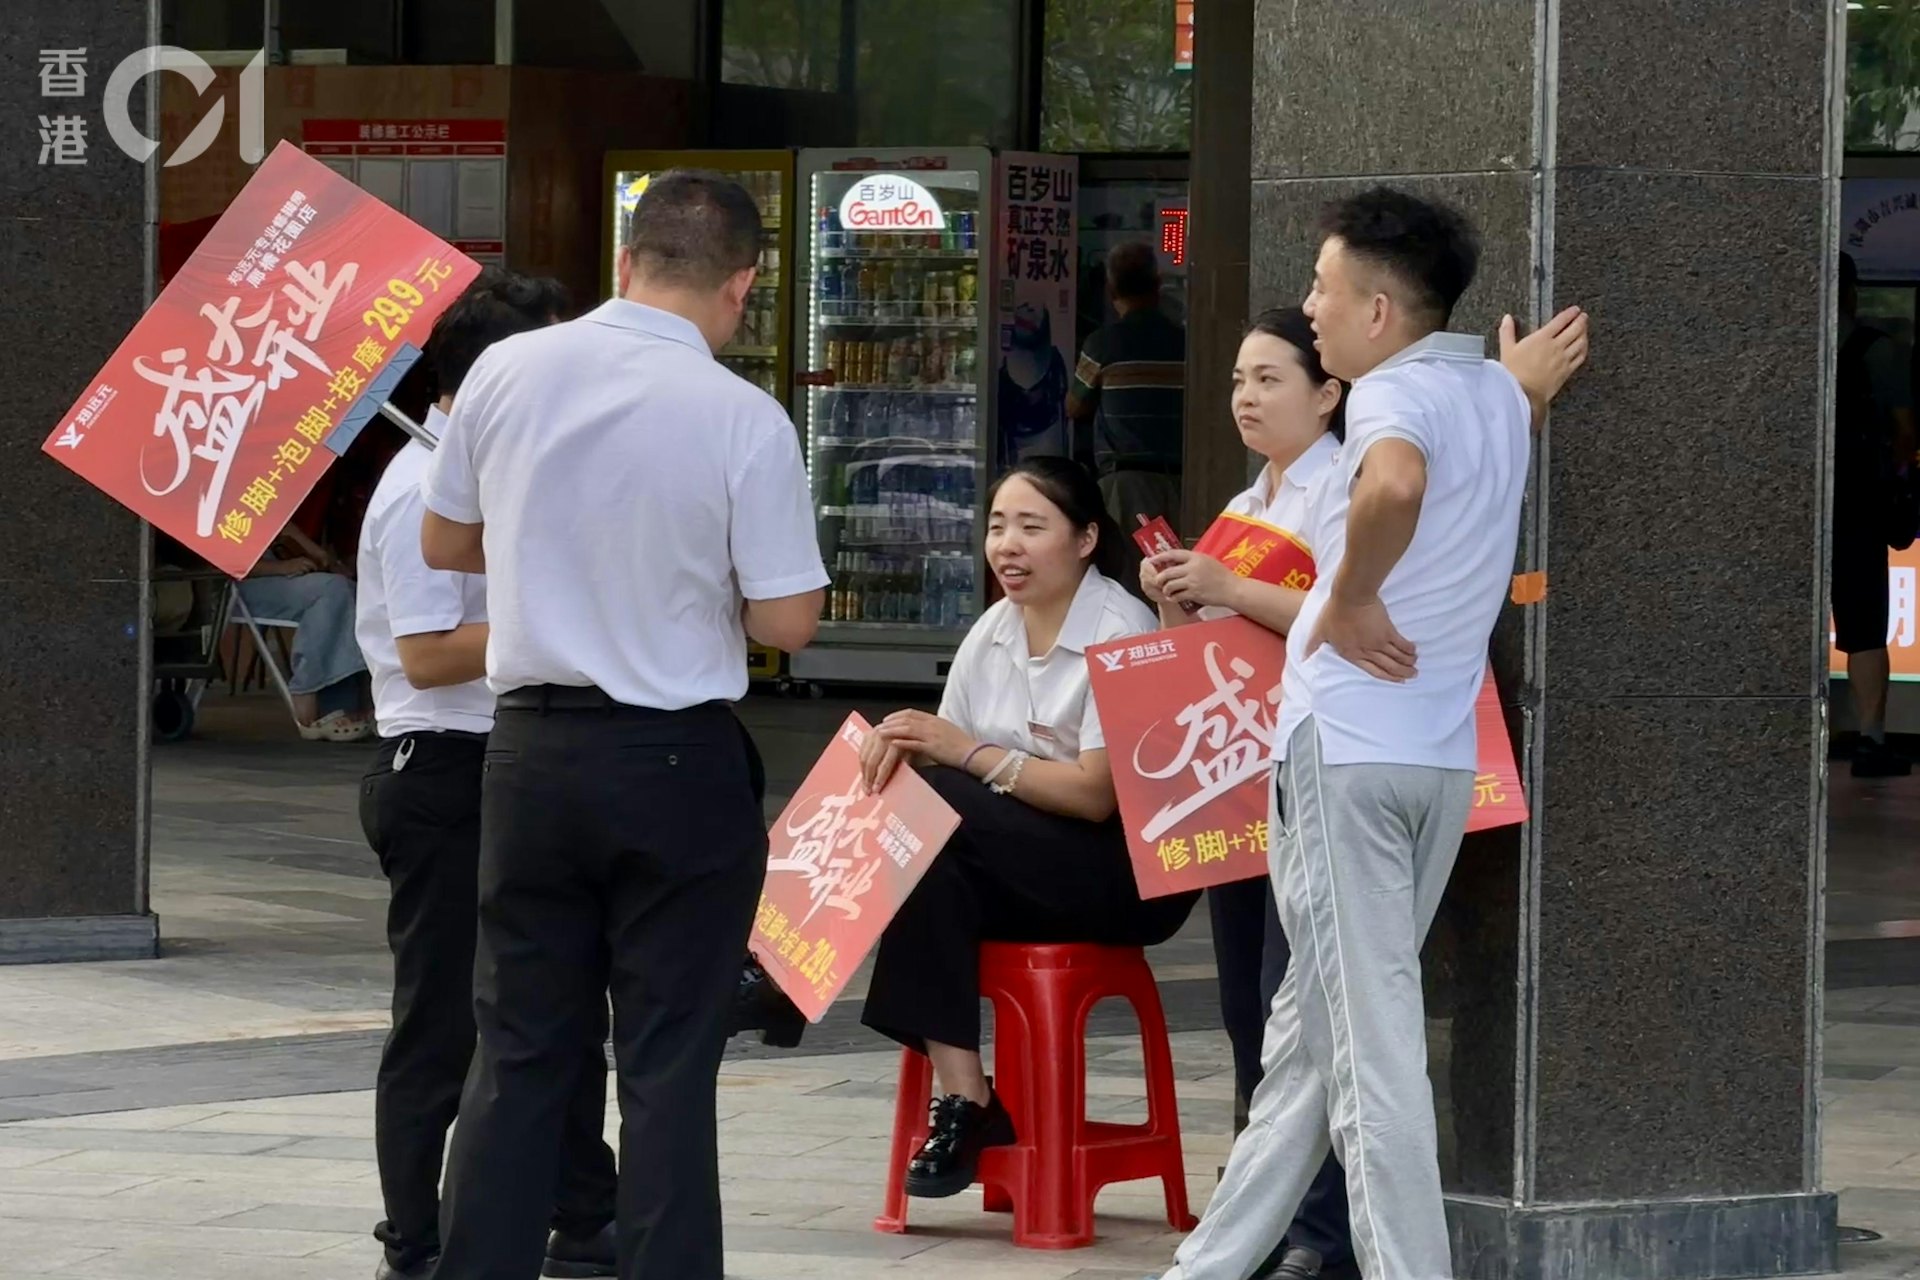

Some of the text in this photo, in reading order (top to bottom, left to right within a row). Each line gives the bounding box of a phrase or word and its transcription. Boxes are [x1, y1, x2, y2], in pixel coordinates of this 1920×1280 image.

[859, 181, 915, 202] 百岁山
[1008, 164, 1073, 203] 百岁山
[1008, 203, 1071, 236] 真正天然
[1007, 237, 1070, 283] 矿泉水
[75, 383, 113, 426] 郑远元
[1127, 638, 1177, 661] 郑远元
[1475, 772, 1505, 808] 元
